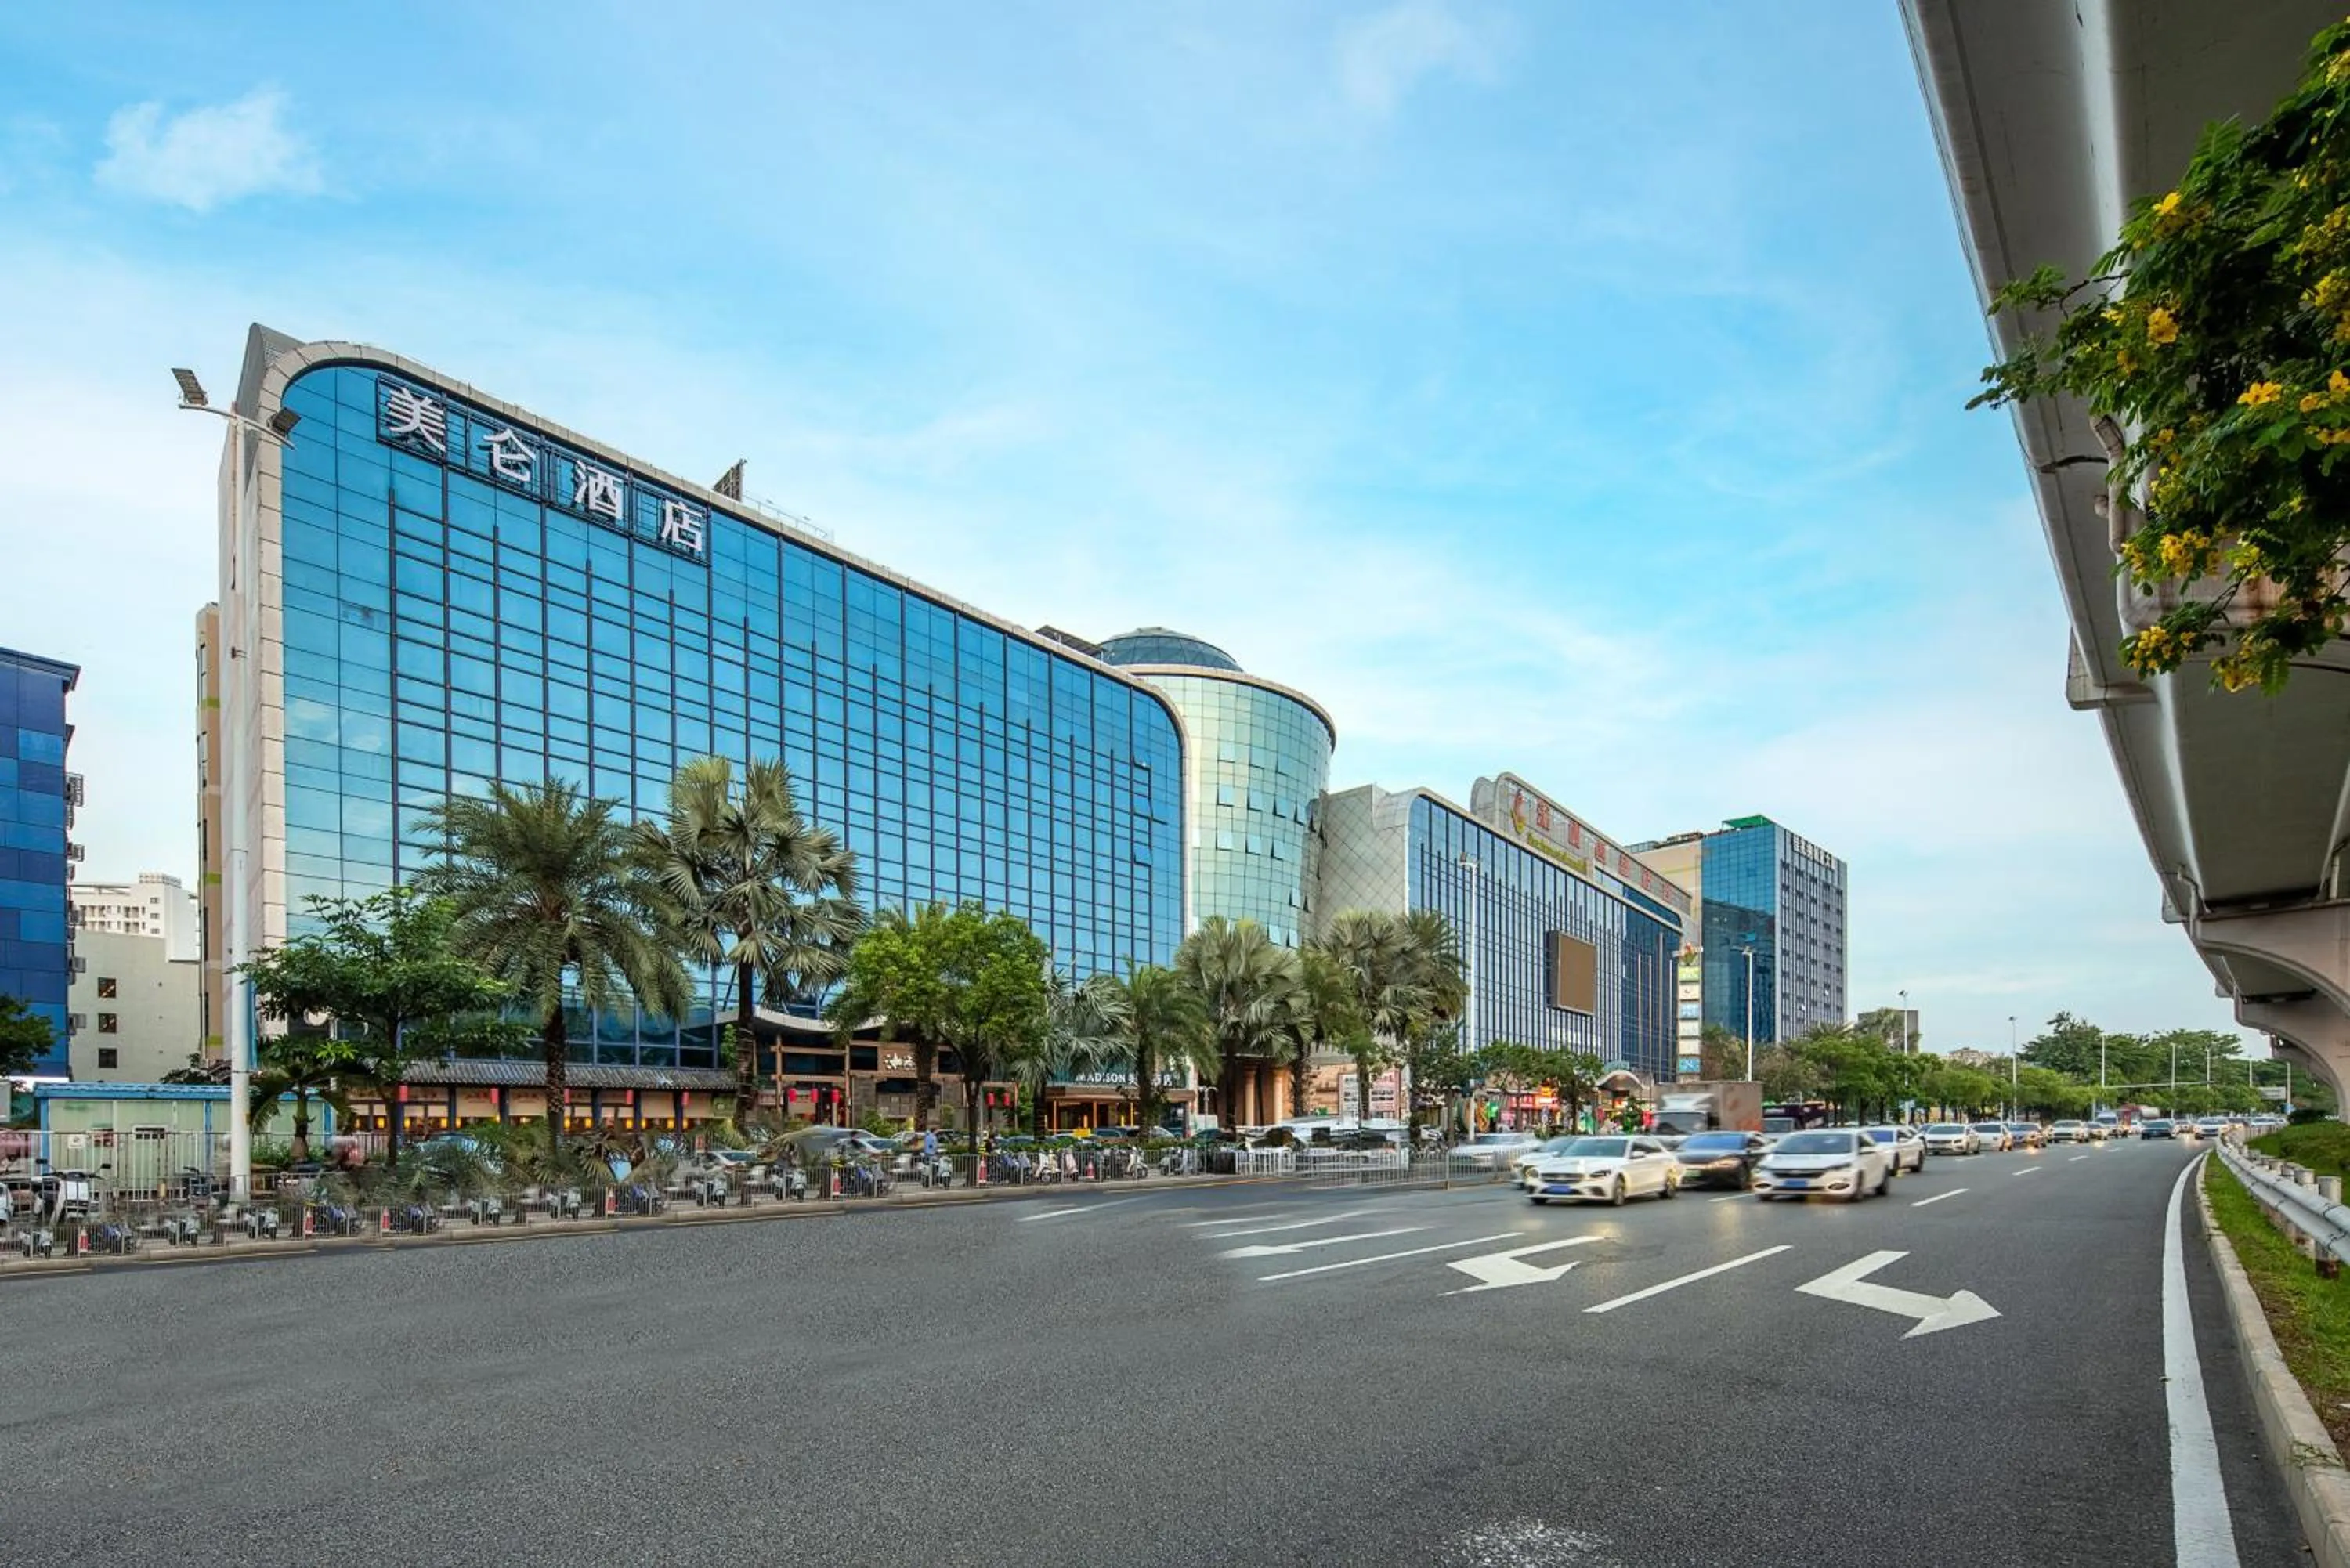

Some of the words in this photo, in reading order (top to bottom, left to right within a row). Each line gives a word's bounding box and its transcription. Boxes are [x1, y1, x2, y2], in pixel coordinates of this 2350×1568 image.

[387, 387, 703, 551] 美仑酒店
[1075, 1072, 1126, 1082] MADISON
